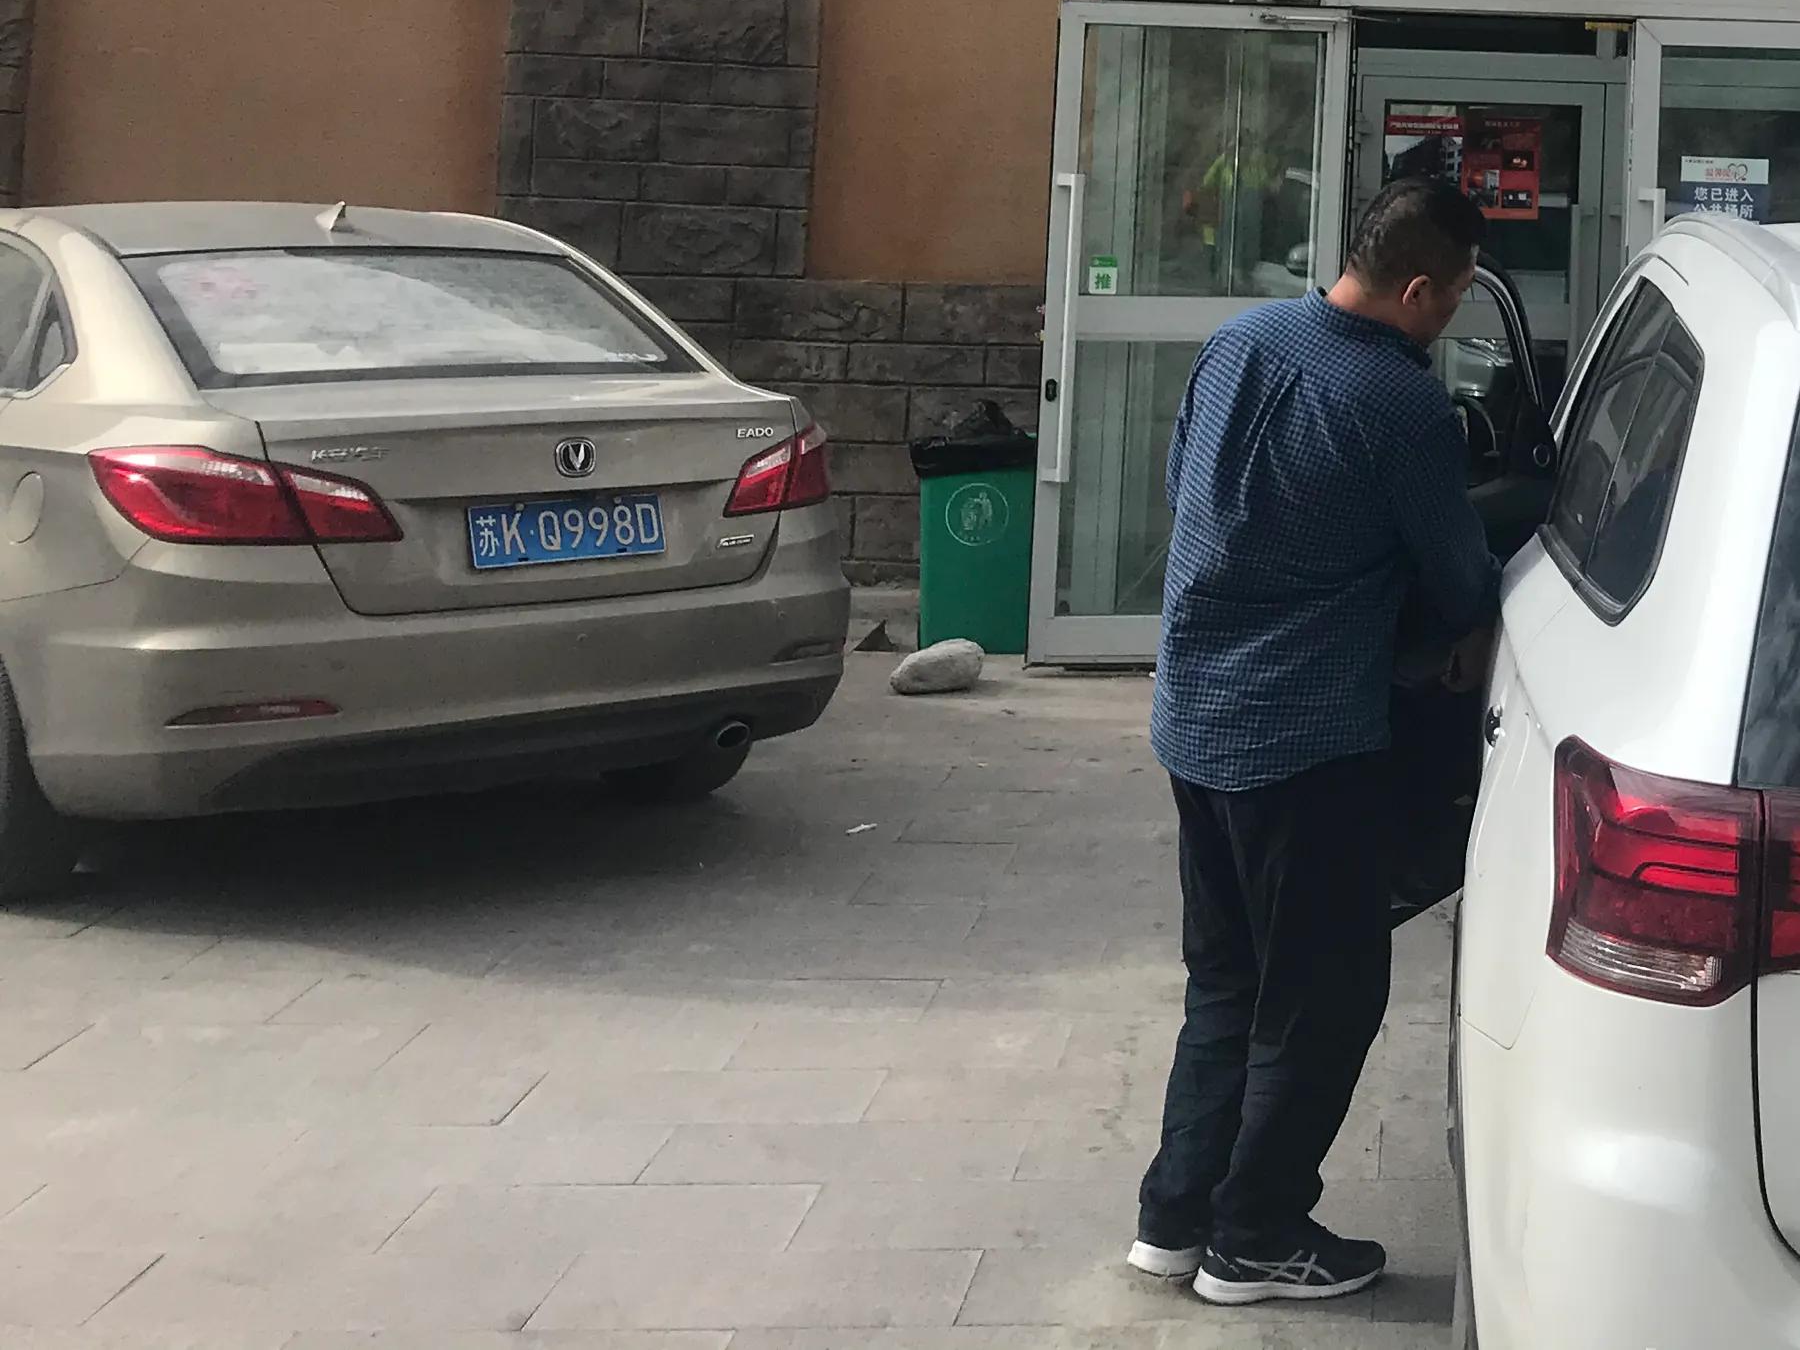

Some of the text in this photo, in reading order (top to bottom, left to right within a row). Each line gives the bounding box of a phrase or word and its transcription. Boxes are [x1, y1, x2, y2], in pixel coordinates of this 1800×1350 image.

[1694, 187, 1753, 202] 您已进入
[1095, 273, 1111, 290] 推
[737, 427, 774, 438] EADO
